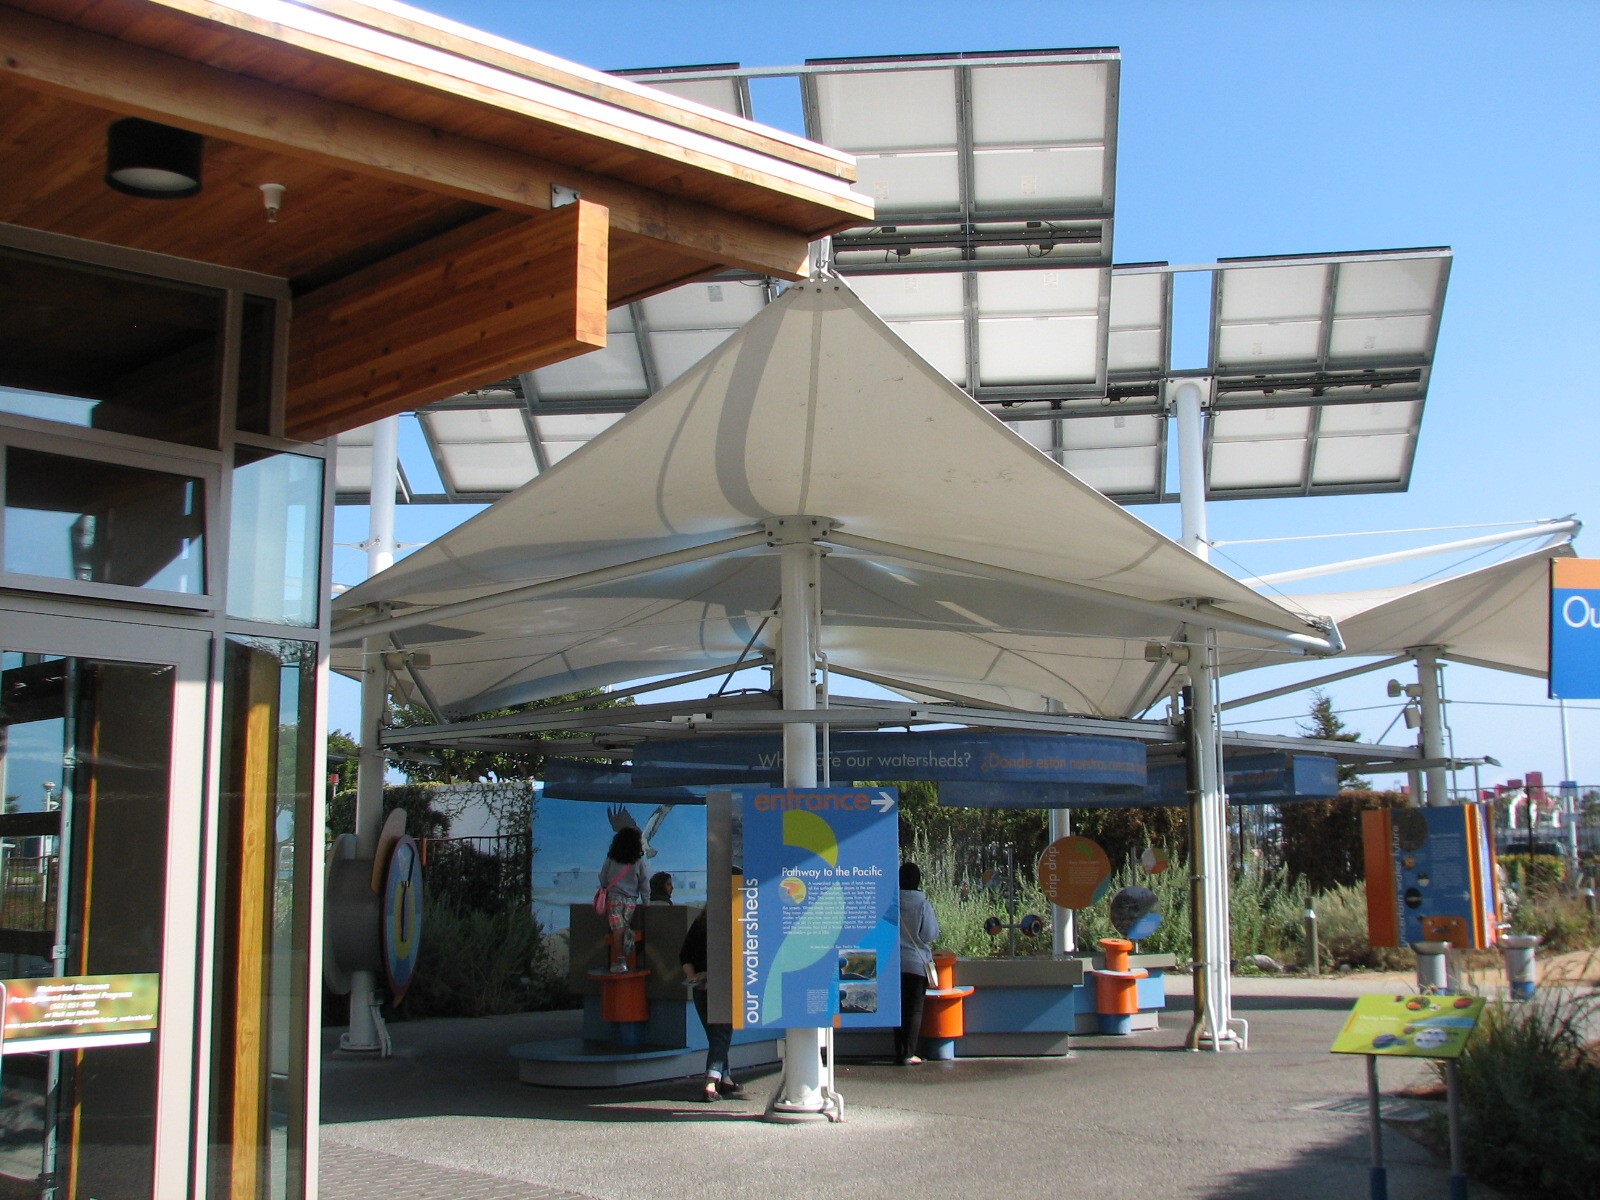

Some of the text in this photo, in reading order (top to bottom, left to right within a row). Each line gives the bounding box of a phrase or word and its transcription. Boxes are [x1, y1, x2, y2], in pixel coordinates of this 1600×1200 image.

[847, 756, 873, 767] our
[878, 750, 971, 767] watersheds?
[754, 789, 871, 811] entrance
[1390, 825, 1400, 857] future
[782, 865, 883, 879] Pathway to the Pacific
[1044, 846, 1060, 898] drip drip
[738, 878, 759, 1024] our watersheds
